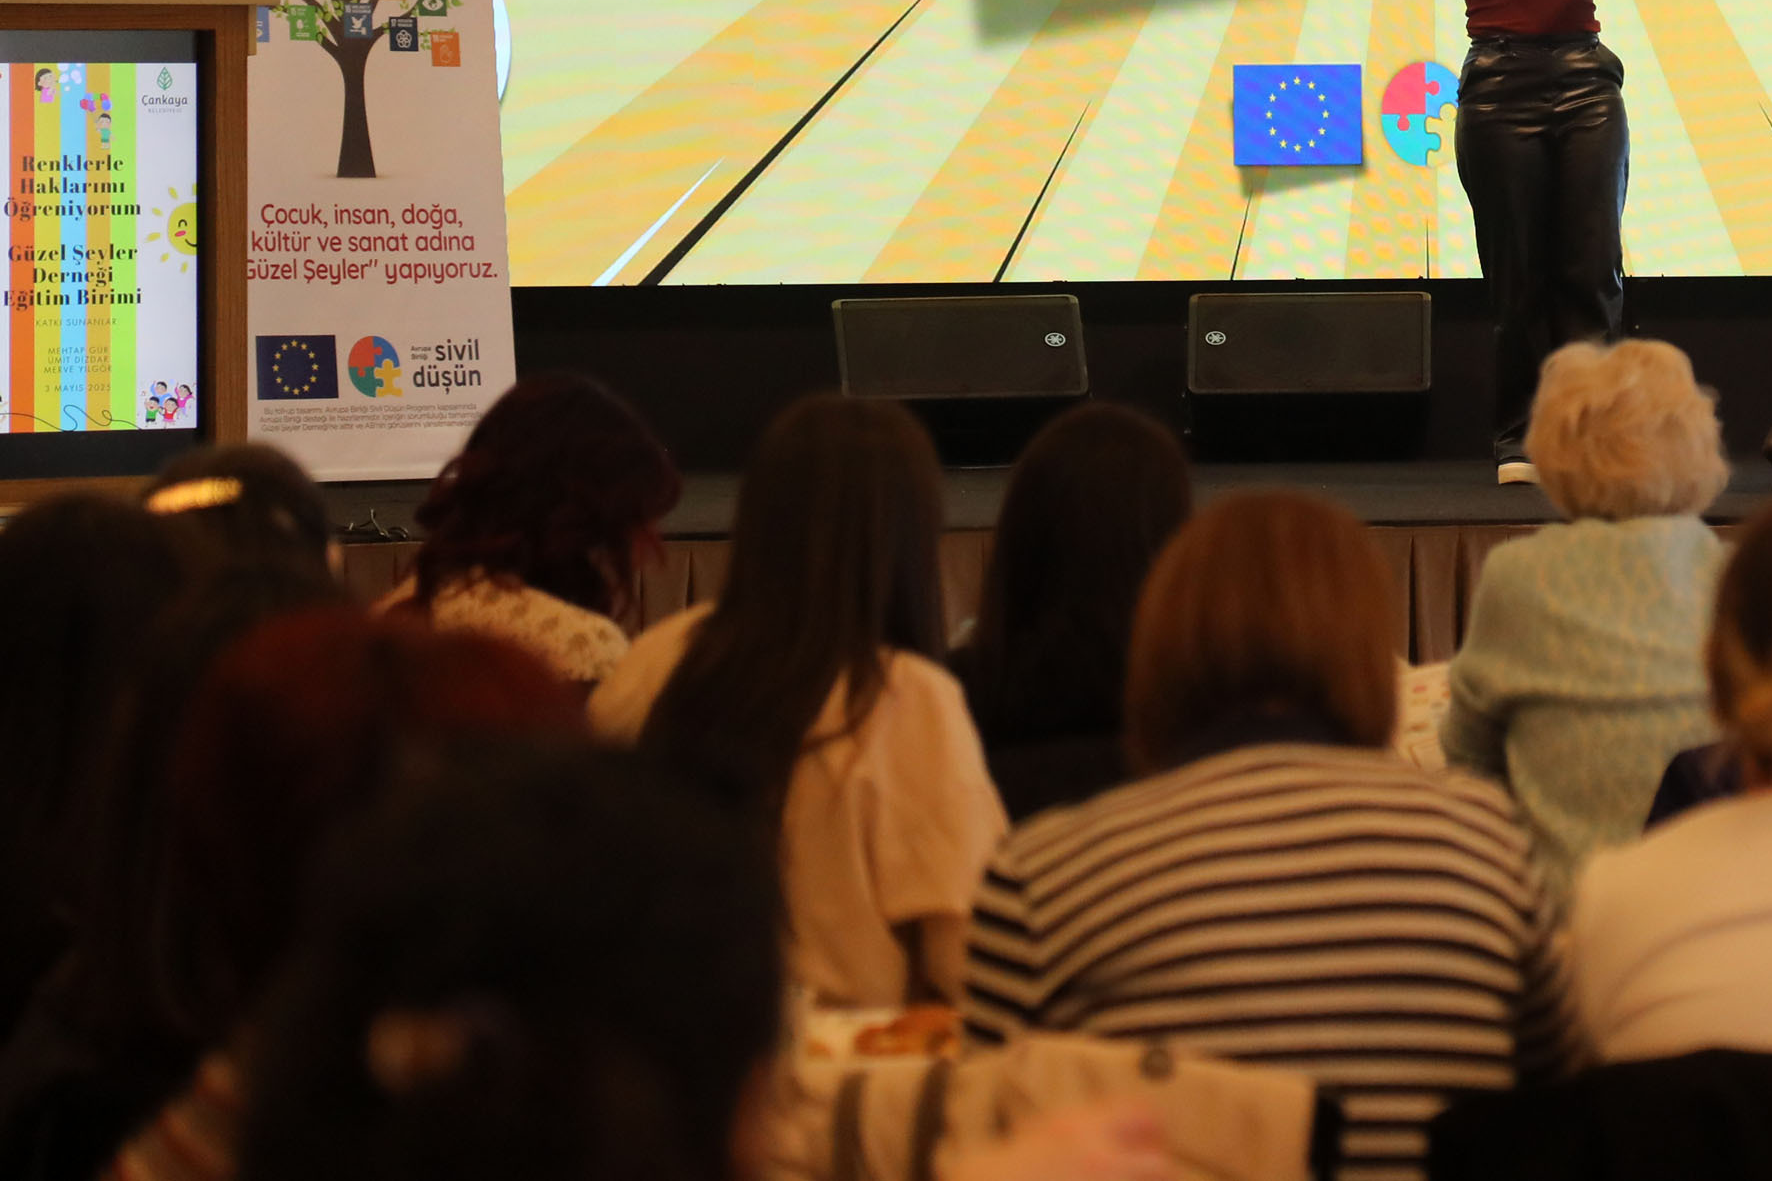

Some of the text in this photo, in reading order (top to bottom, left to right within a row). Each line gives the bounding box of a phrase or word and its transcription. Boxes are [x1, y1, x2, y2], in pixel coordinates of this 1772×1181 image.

[141, 94, 188, 107] Çankaya
[22, 154, 124, 172] Renklerle
[20, 176, 126, 194] Haklarımı
[3, 196, 141, 223] Öğreniyorum
[260, 203, 463, 230] Çocuk, insan, doğa,
[251, 231, 475, 252] kültür ve sanat adına
[8, 243, 138, 266] Güzel Şeyler
[32, 266, 113, 288] Derneği
[385, 261, 498, 285] yapıyoruz.
[3, 288, 142, 311] Eğitim Birimi
[435, 338, 480, 362] sivil
[412, 364, 482, 395] düşün
